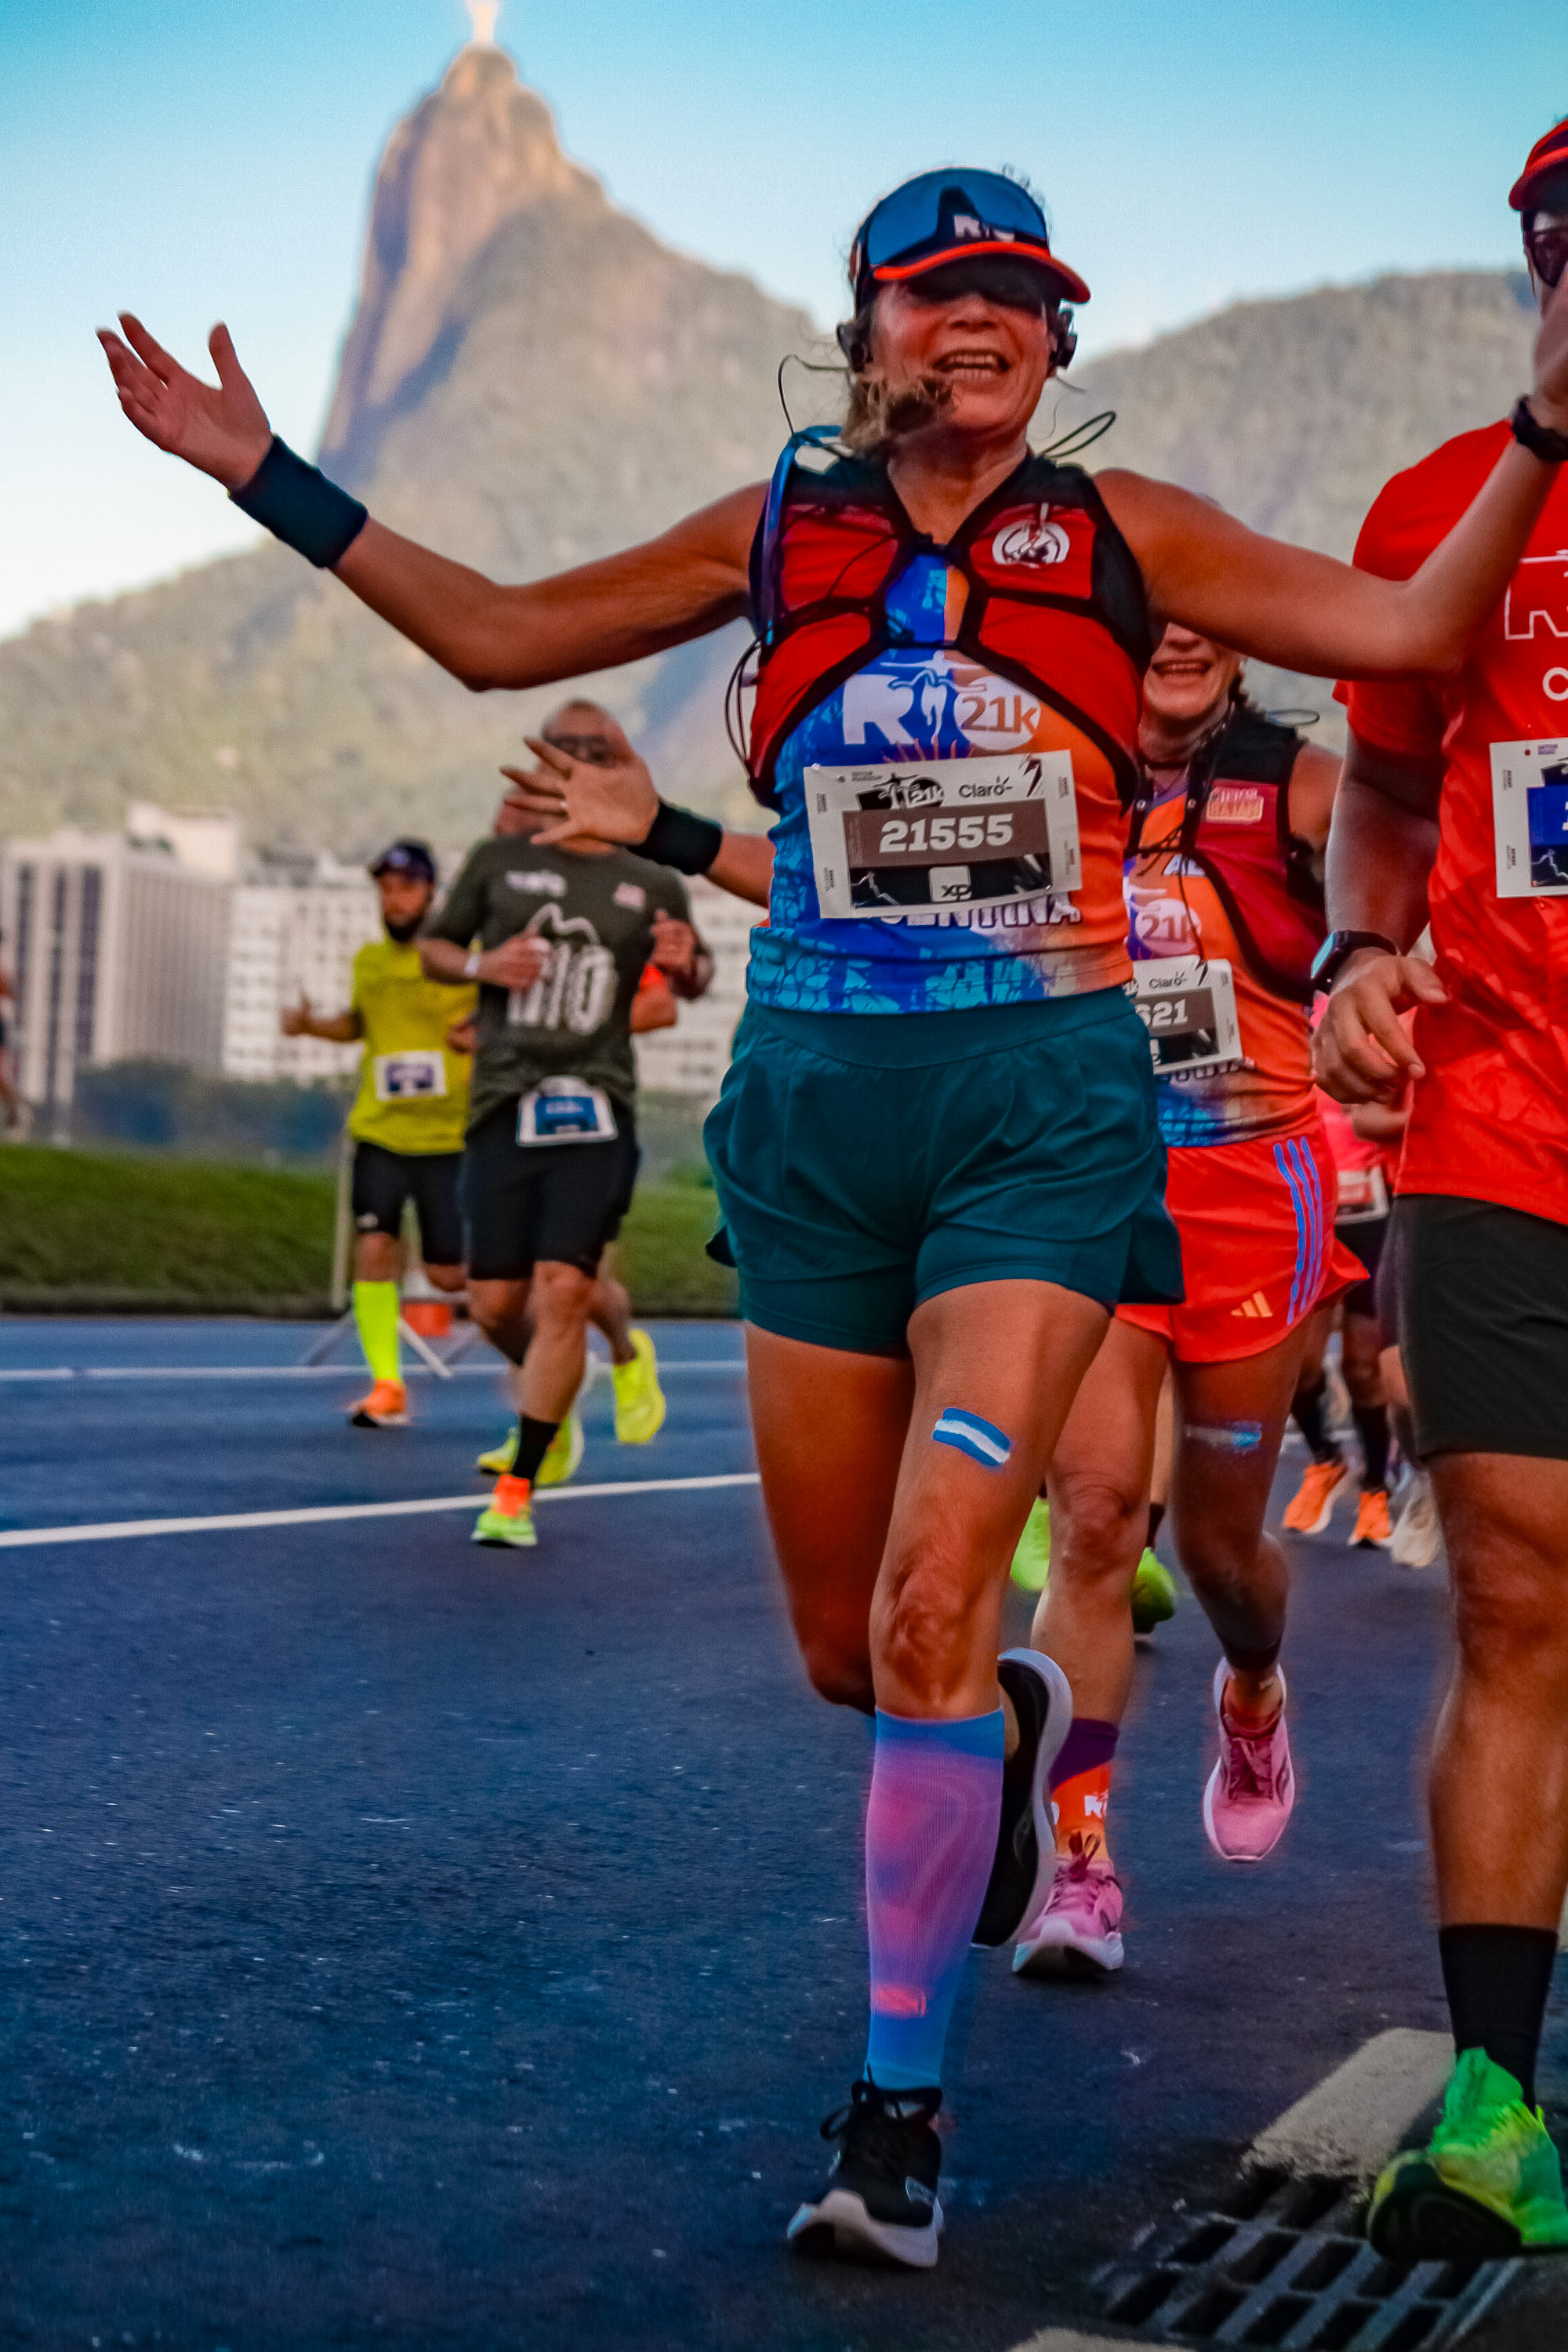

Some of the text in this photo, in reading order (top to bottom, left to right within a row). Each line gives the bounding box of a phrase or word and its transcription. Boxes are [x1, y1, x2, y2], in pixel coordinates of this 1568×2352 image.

[961, 694, 1040, 734] 21k
[958, 778, 1010, 798] Claro
[879, 812, 1014, 854] 21555
[1149, 973, 1185, 989] Claro
